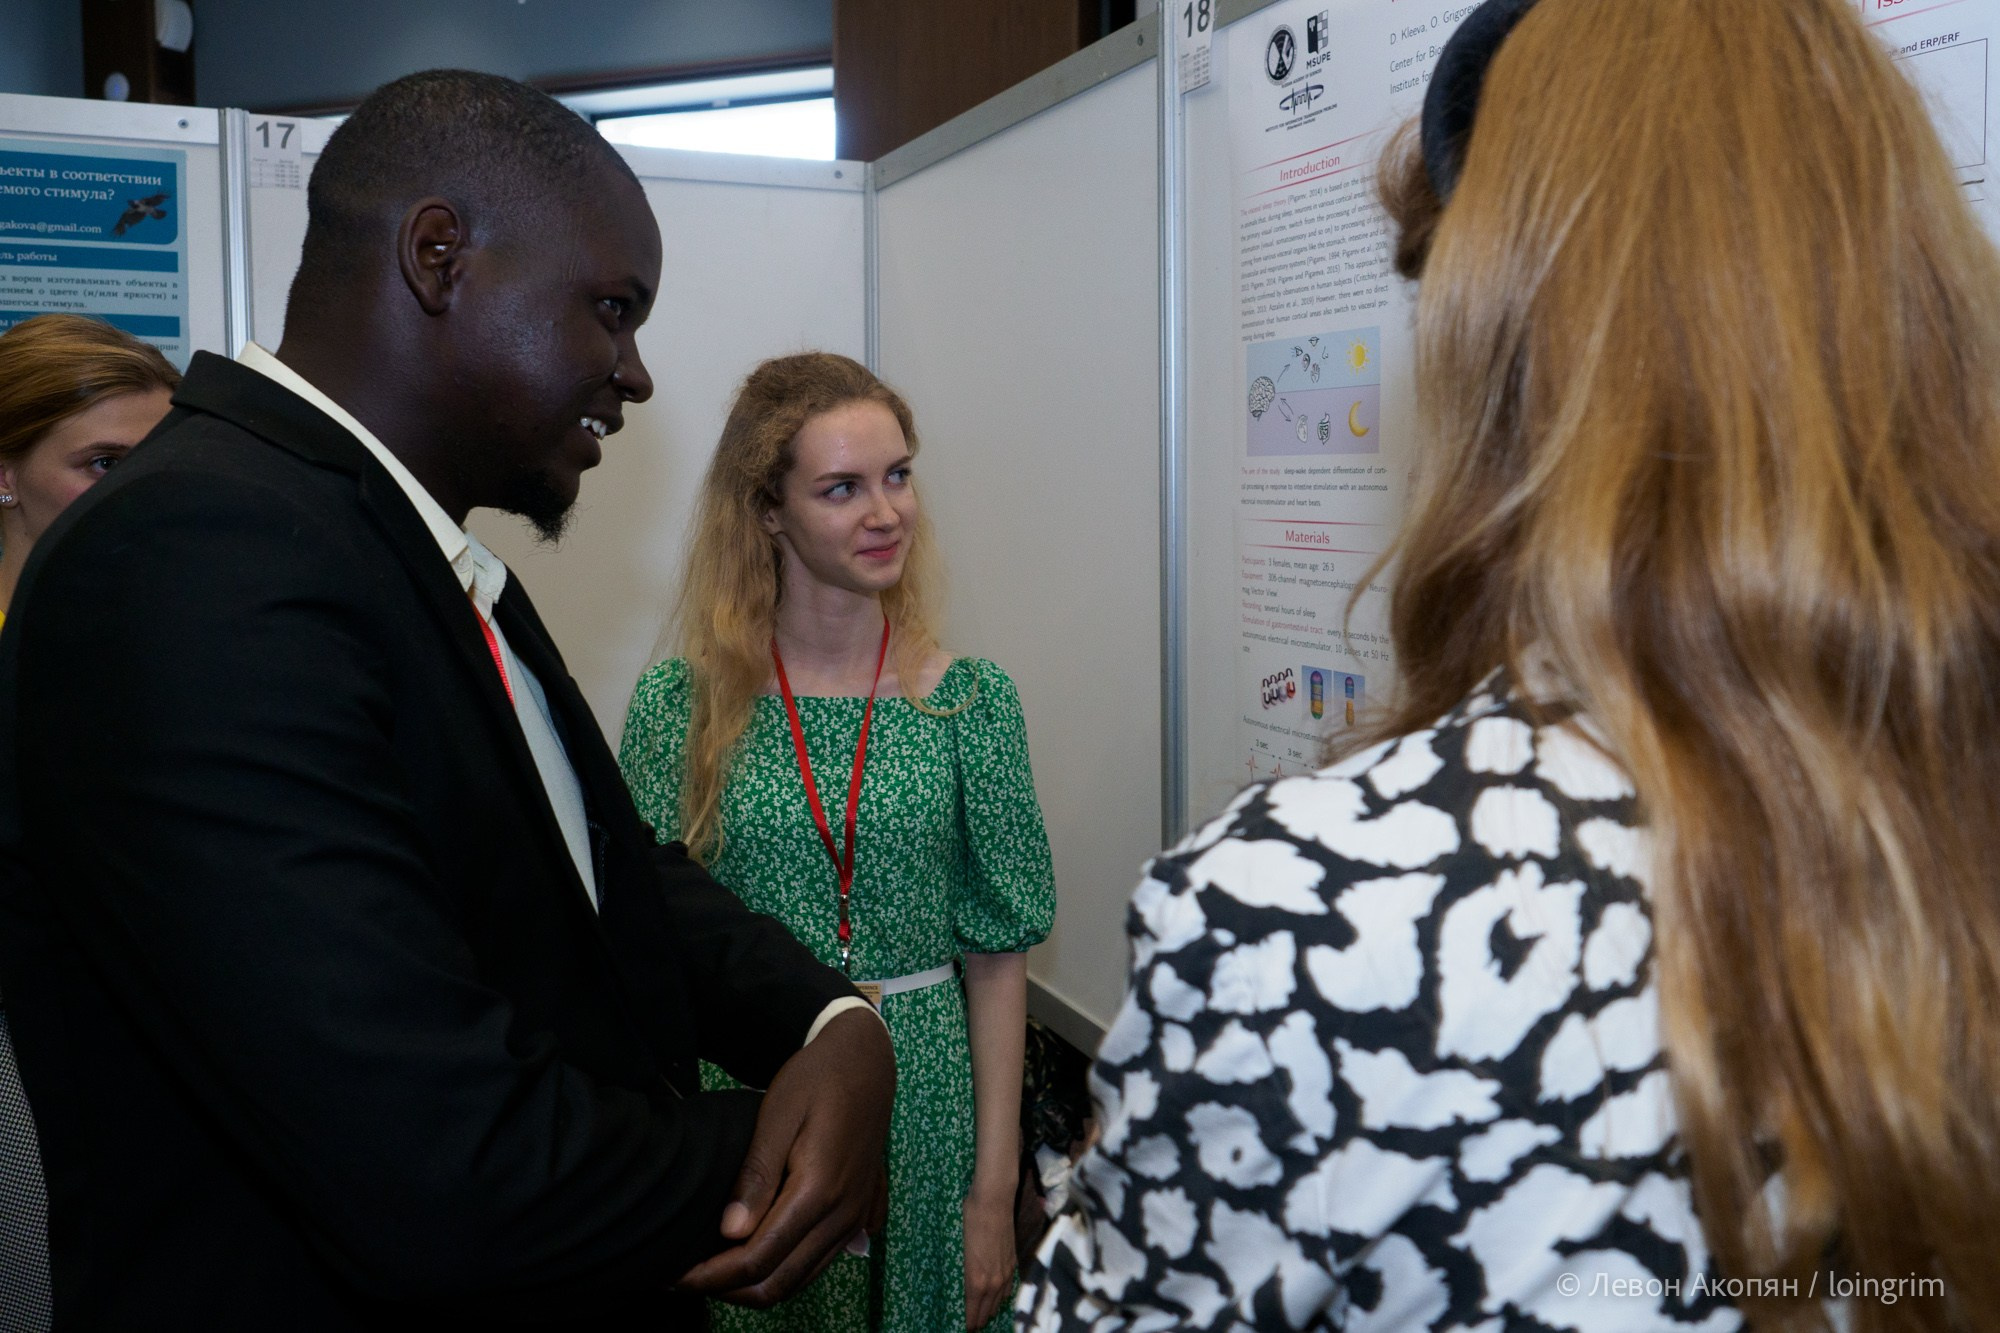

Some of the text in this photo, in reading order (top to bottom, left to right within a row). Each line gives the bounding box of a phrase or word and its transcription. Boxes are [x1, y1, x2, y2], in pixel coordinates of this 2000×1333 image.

[1184, 0, 1210, 38] 18
[1900, 42, 1917, 54] and
[1920, 32, 1960, 50] ERP/ERF
[1306, 52, 1331, 70] MSUPE
[1390, 57, 1413, 72] Center
[1416, 50, 1426, 63] for
[1390, 77, 1419, 94] Institute
[256, 121, 296, 149] 17
[1280, 156, 1340, 181] Introduction
[50, 171, 58, 179] в
[62, 170, 162, 186] соответствии
[44, 187, 115, 202] стимула?
[17, 252, 57, 262] работы
[12, 276, 42, 285] ворон
[47, 277, 121, 286] изготавливать
[126, 279, 168, 289] объекты
[50, 289, 78, 298] цвете
[124, 291, 167, 300] яркости)
[1333, 465, 1365, 474] differentiation
[1339, 483, 1349, 491] with
[1285, 530, 1330, 544] Materials
[1256, 739, 1259, 747] 3
[1288, 748, 1292, 756] 3
